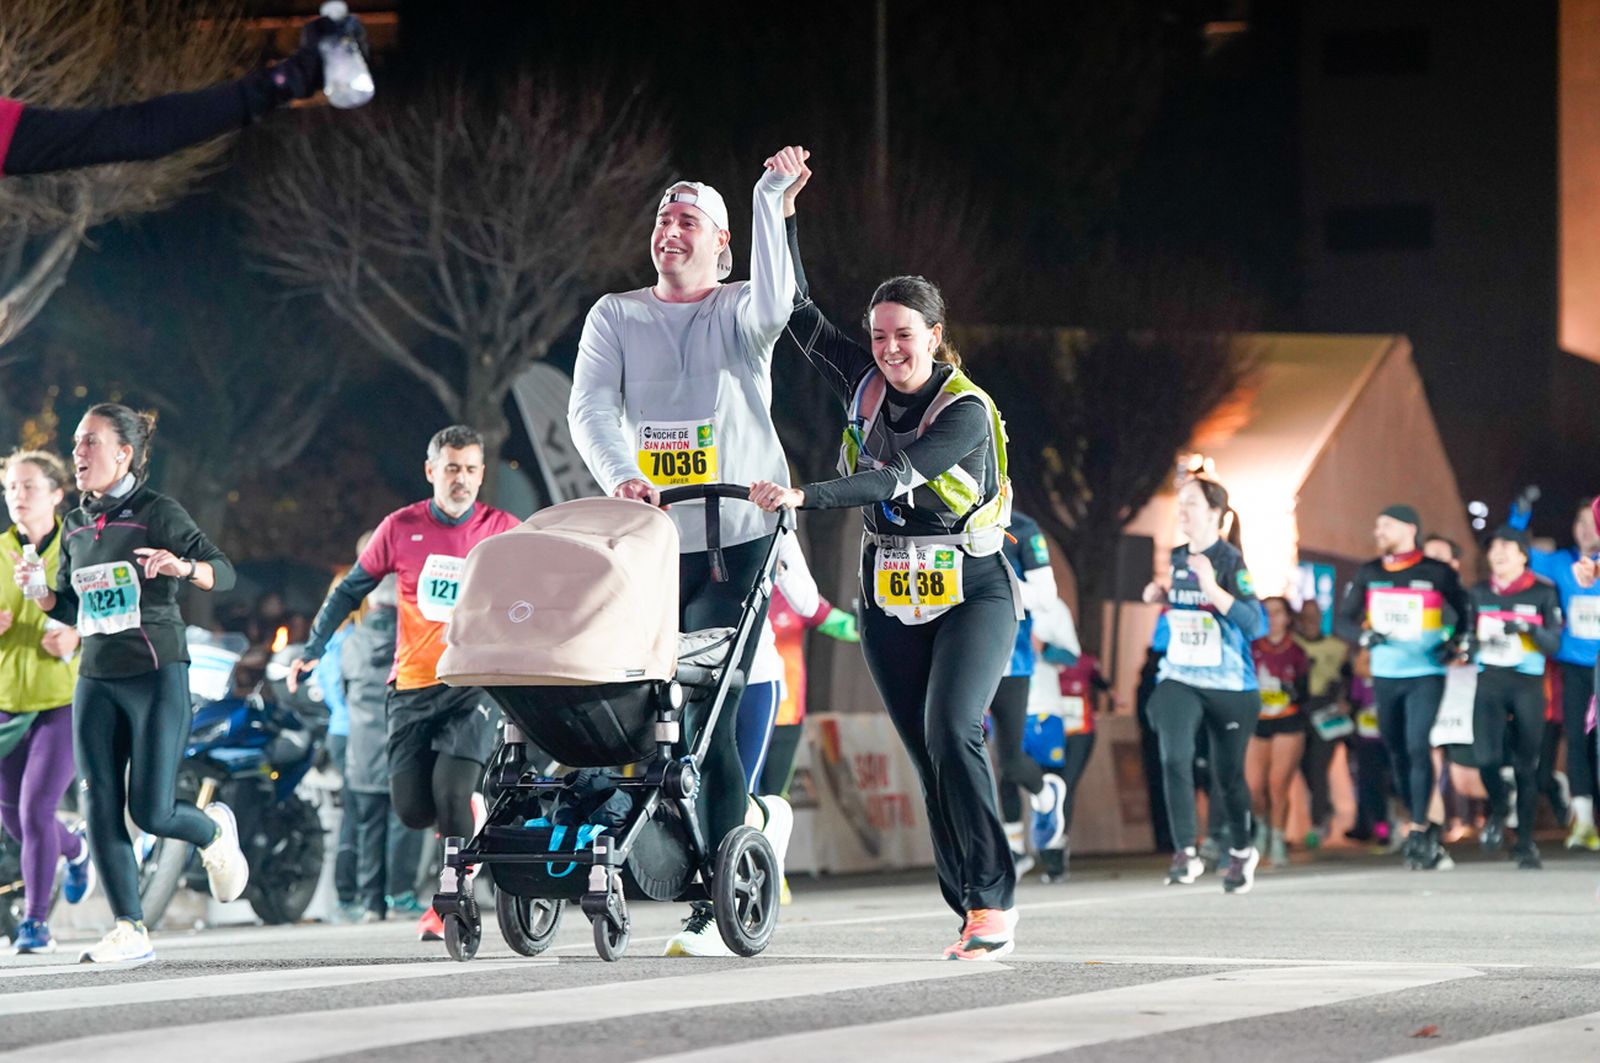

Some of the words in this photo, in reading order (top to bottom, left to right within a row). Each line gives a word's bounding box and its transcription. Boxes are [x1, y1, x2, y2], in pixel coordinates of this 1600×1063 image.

[652, 431, 677, 440] NOCHE
[678, 430, 689, 439] DE
[644, 440, 660, 450] SAN
[650, 450, 707, 477] 7036
[883, 561, 898, 571] SAN
[899, 561, 926, 571] ANN
